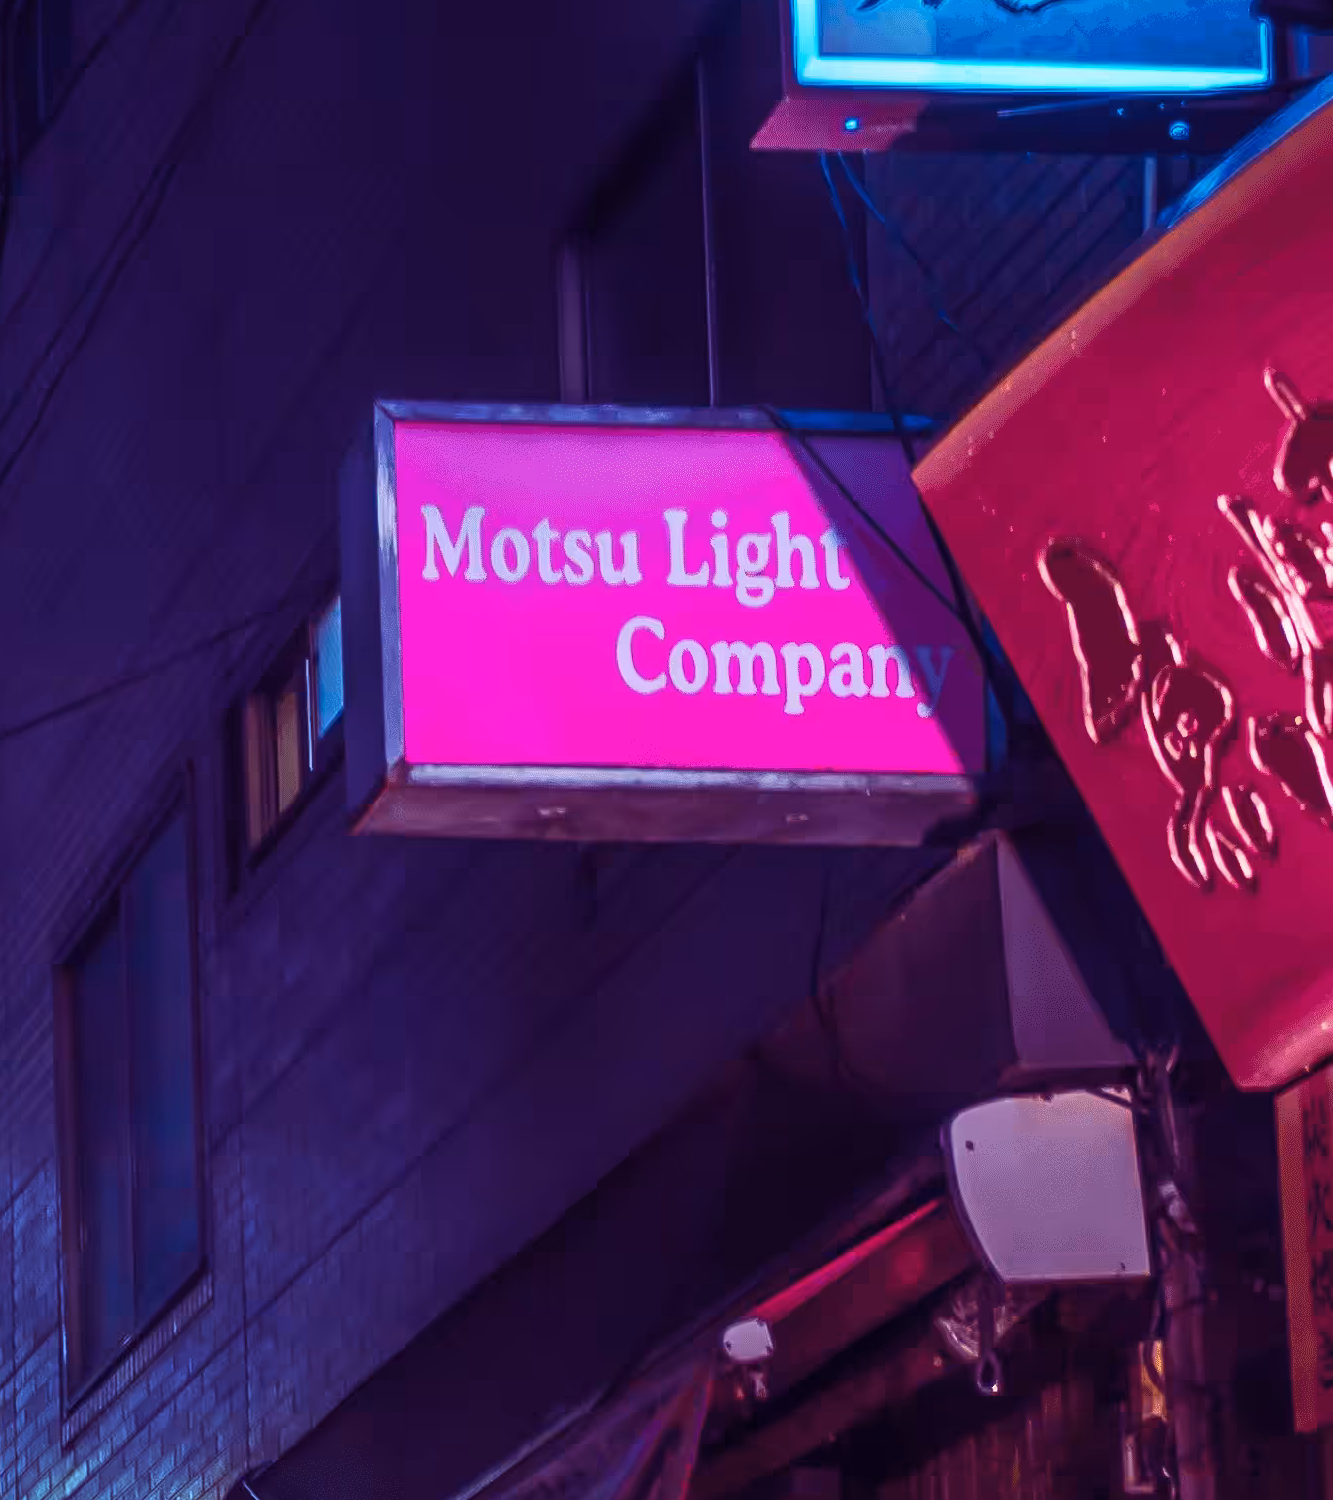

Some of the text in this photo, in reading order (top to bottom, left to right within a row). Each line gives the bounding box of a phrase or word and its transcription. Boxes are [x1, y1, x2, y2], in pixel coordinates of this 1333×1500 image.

[419, 502, 851, 609] Motsu Light
[615, 614, 955, 719] Company
